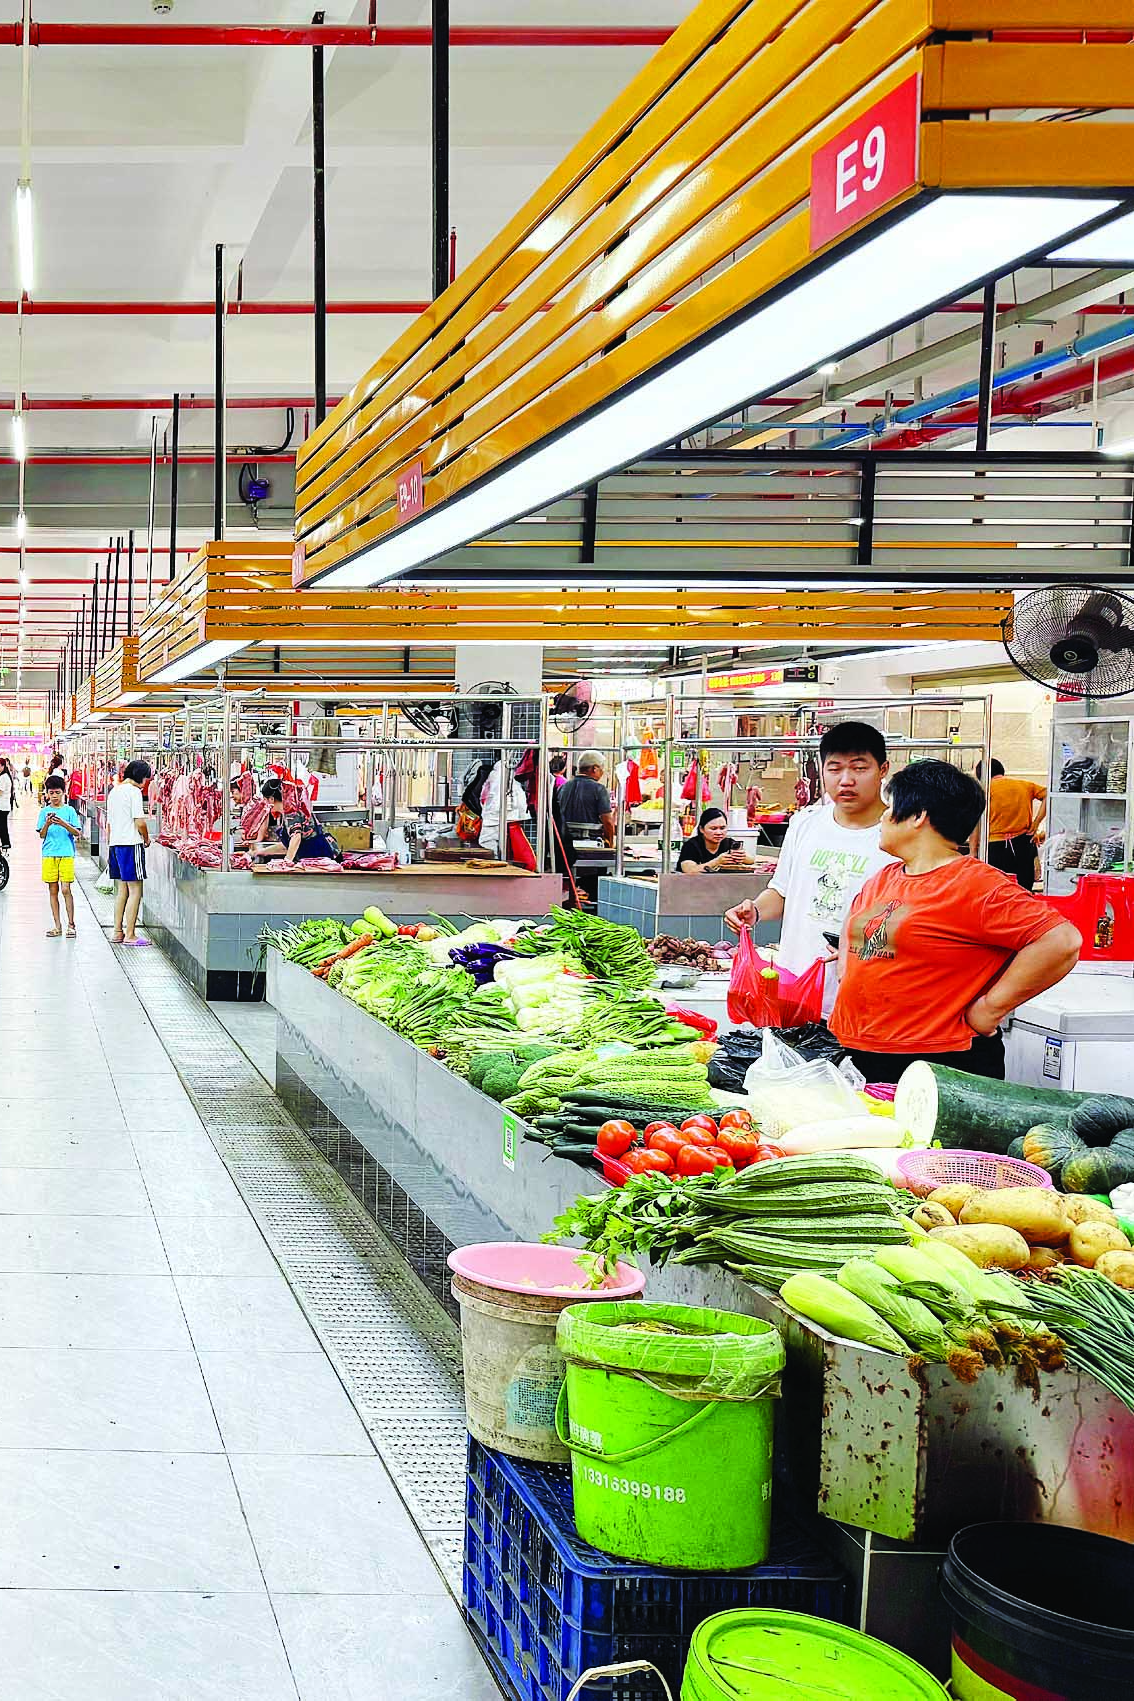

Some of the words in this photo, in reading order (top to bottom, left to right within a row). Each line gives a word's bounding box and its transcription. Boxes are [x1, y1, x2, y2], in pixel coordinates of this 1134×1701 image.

[835, 125, 886, 214] E9
[399, 474, 418, 513] E9-10
[583, 1466, 686, 1504] 13316399188
